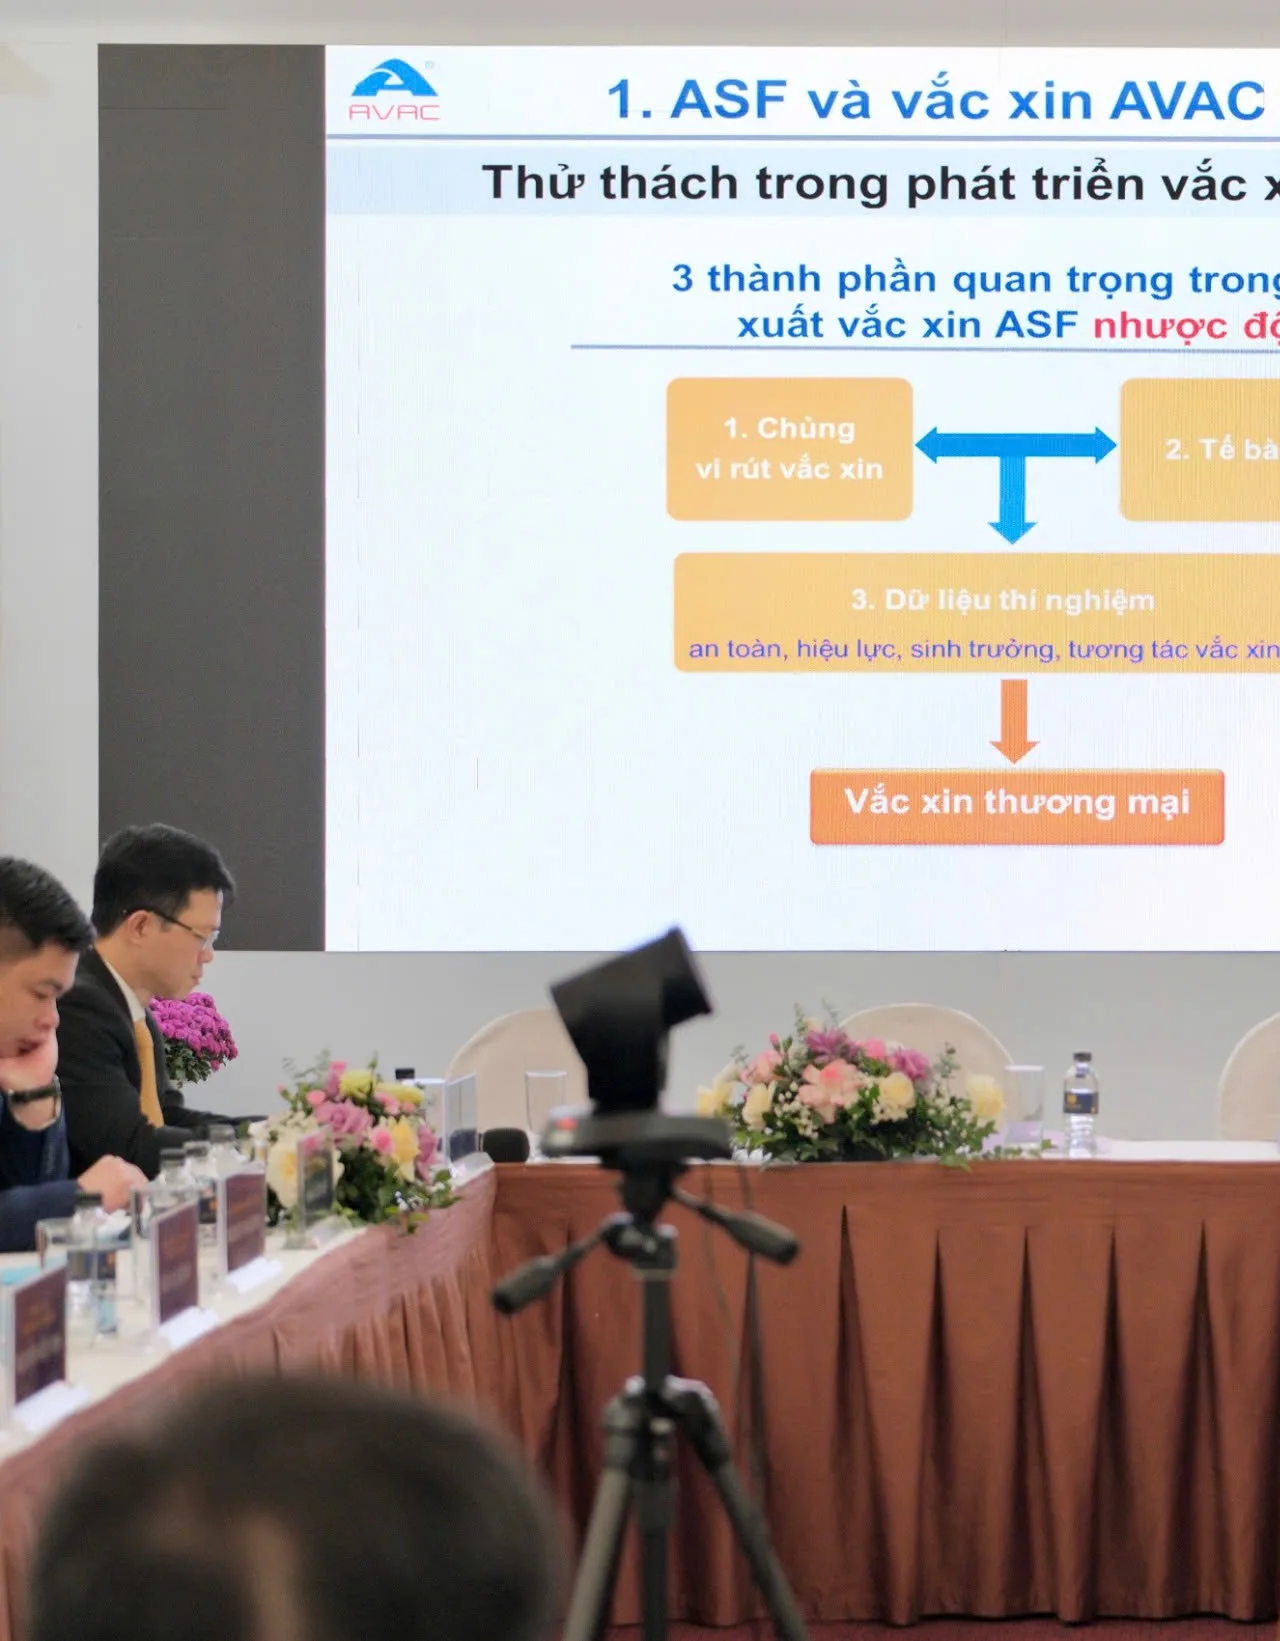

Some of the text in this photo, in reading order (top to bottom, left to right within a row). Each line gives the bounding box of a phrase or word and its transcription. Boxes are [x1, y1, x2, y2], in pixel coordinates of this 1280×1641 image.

[606, 77, 653, 120] 1.
[670, 77, 788, 121] ASF
[807, 78, 872, 121] và
[890, 69, 990, 122] vắc
[1008, 79, 1093, 121] xin
[1108, 79, 1266, 122] AVAC
[348, 103, 441, 122] AVAC
[481, 162, 586, 201] Thử
[599, 163, 738, 201] thách
[755, 165, 889, 210] trong
[907, 164, 1017, 210] phát
[1031, 156, 1145, 202] triển
[1160, 157, 1247, 202] vắc
[671, 263, 694, 293] 3
[707, 262, 822, 294] thành
[837, 256, 937, 302] phần
[952, 270, 1053, 301] quan
[1066, 265, 1174, 302] trọng
[737, 302, 825, 339] xuất
[836, 302, 907, 340] vắc
[921, 308, 982, 340] xin
[993, 308, 1079, 340] ASF
[1093, 309, 1228, 346] nhược
[723, 414, 857, 446] 1. Chủng
[1164, 437, 1190, 461] 2.
[1199, 433, 1236, 461] Tế
[695, 452, 884, 481] vi rút vắc xin
[850, 587, 1157, 617] 3. Dữ liệu thí nghiệm
[688, 642, 720, 659] an
[727, 638, 790, 662] toàn,
[796, 638, 849, 662] hiệu
[856, 638, 903, 662] lực,
[910, 639, 963, 660] sinh
[968, 638, 1062, 664] trưởng,
[1067, 640, 1145, 664] tương
[1151, 640, 1190, 660] tác
[1195, 635, 1239, 660] vắc
[844, 781, 1191, 823] Vắc xin thương mại
